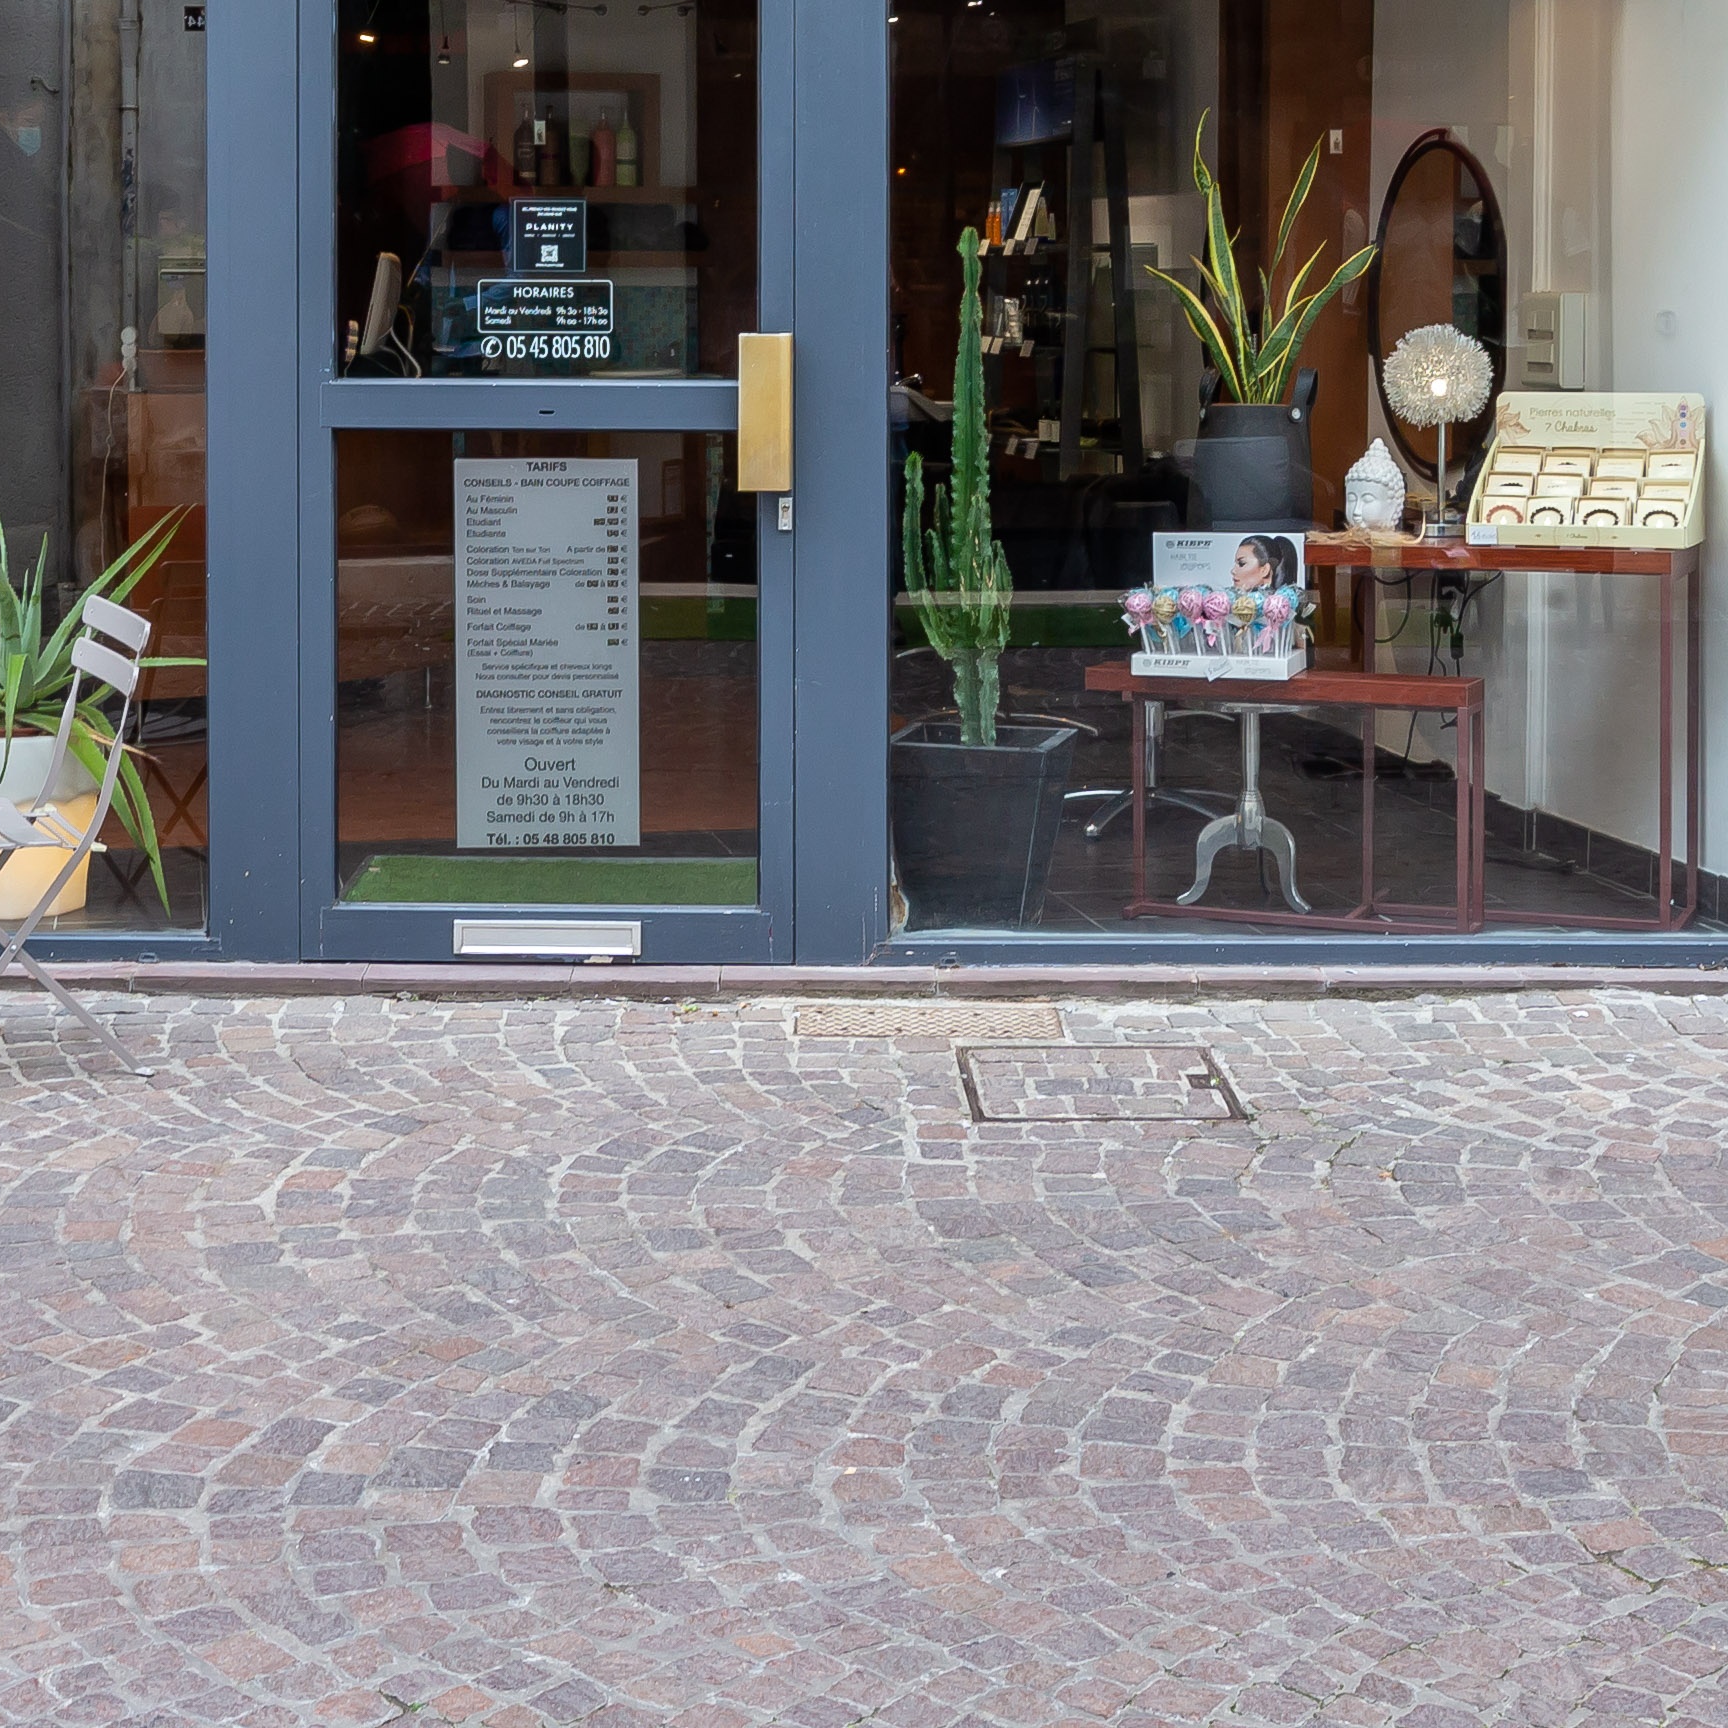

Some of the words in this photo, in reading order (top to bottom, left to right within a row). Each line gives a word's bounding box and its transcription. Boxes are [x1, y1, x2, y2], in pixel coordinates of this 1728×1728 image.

[526, 223, 573, 231] PLANITY
[513, 287, 574, 298] HORAIRES
[485, 306, 506, 315] Mardi
[520, 306, 552, 315] Vendredi
[485, 316, 511, 325] Samedi
[506, 336, 526, 359] 05
[529, 336, 549, 359] 45
[552, 336, 580, 359] 805
[584, 336, 610, 359] 810
[1529, 407, 1563, 418] Pierres
[1566, 407, 1616, 418] naturelles
[526, 462, 567, 472] TARIFS
[464, 478, 512, 487] CONSEILS
[521, 478, 543, 487] BAIN
[546, 478, 580, 487] COUPE
[582, 478, 630, 487] COIFFAGE
[480, 506, 517, 514] Masculin
[466, 545, 509, 553] Coloration
[466, 556, 509, 565] Coloration
[559, 568, 602, 576] Coloration
[467, 596, 486, 604] Soin
[467, 623, 494, 631] Forfait
[467, 639, 494, 647] Forfait
[476, 689, 535, 699] DIAGNOSTIC
[538, 689, 579, 699] CONSEIL
[582, 689, 623, 699] GRATUIT
[524, 757, 576, 772] Ouvert
[481, 777, 499, 789] Du
[503, 776, 539, 789] Mardi
[543, 779, 559, 789] au
[563, 776, 620, 789] Vendredi
[497, 794, 513, 806] de
[517, 794, 548, 806] 9h30
[552, 794, 561, 806] à
[565, 794, 605, 806] 18h30
[486, 810, 535, 823] Samedi
[538, 811, 555, 823] de
[559, 811, 575, 823] 9h
[579, 810, 587, 823] à
[592, 811, 615, 823] 17h
[523, 833, 539, 845] 05
[562, 833, 587, 845] 805
[590, 833, 615, 845] 810
